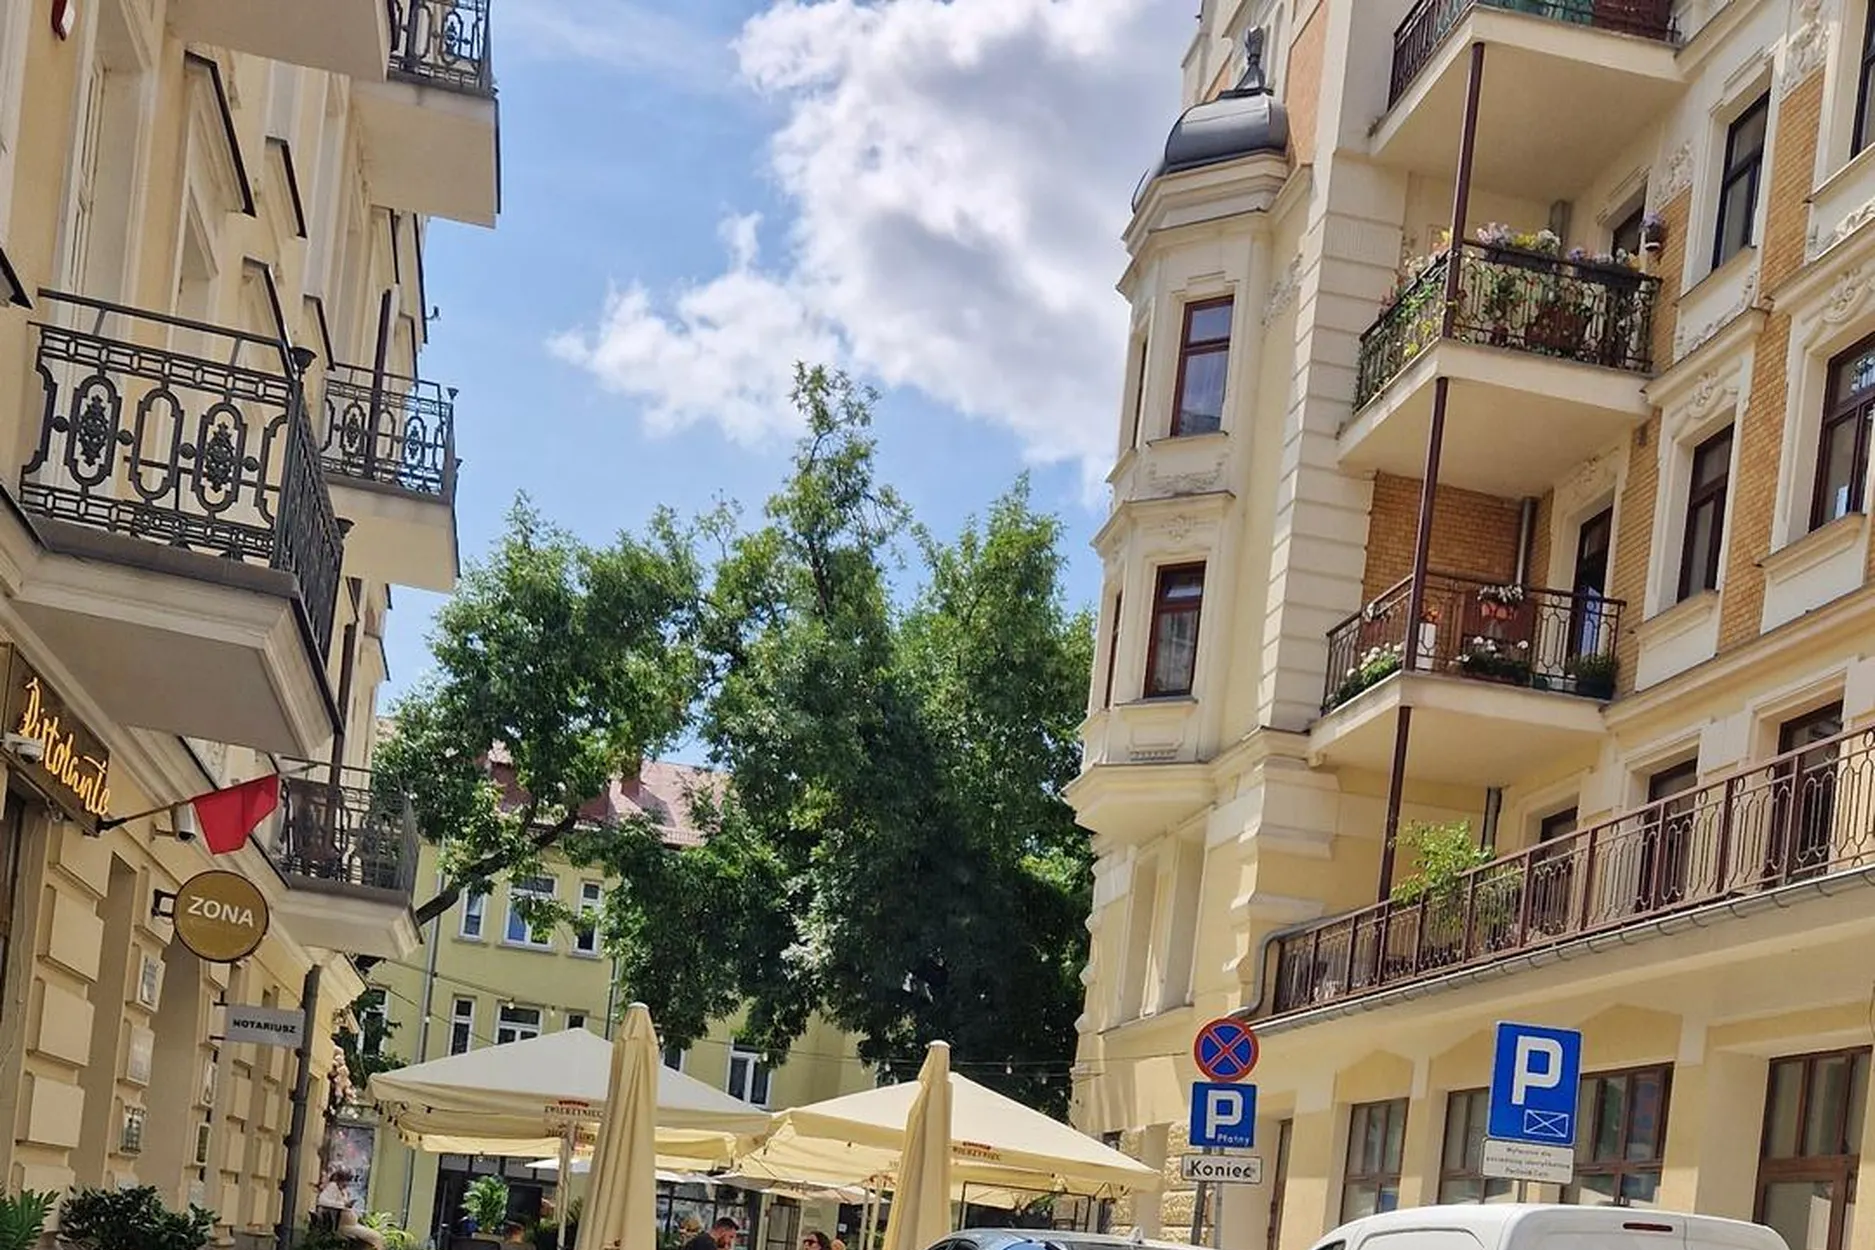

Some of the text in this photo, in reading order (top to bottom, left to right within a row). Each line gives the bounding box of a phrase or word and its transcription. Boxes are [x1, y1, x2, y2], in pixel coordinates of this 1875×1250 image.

[188, 896, 254, 928] ZONA
[232, 1018, 297, 1034] NOTARIUSZ
[1511, 1035, 1563, 1105] P
[1205, 1090, 1244, 1139] P
[1190, 1160, 1252, 1178] Koniec
